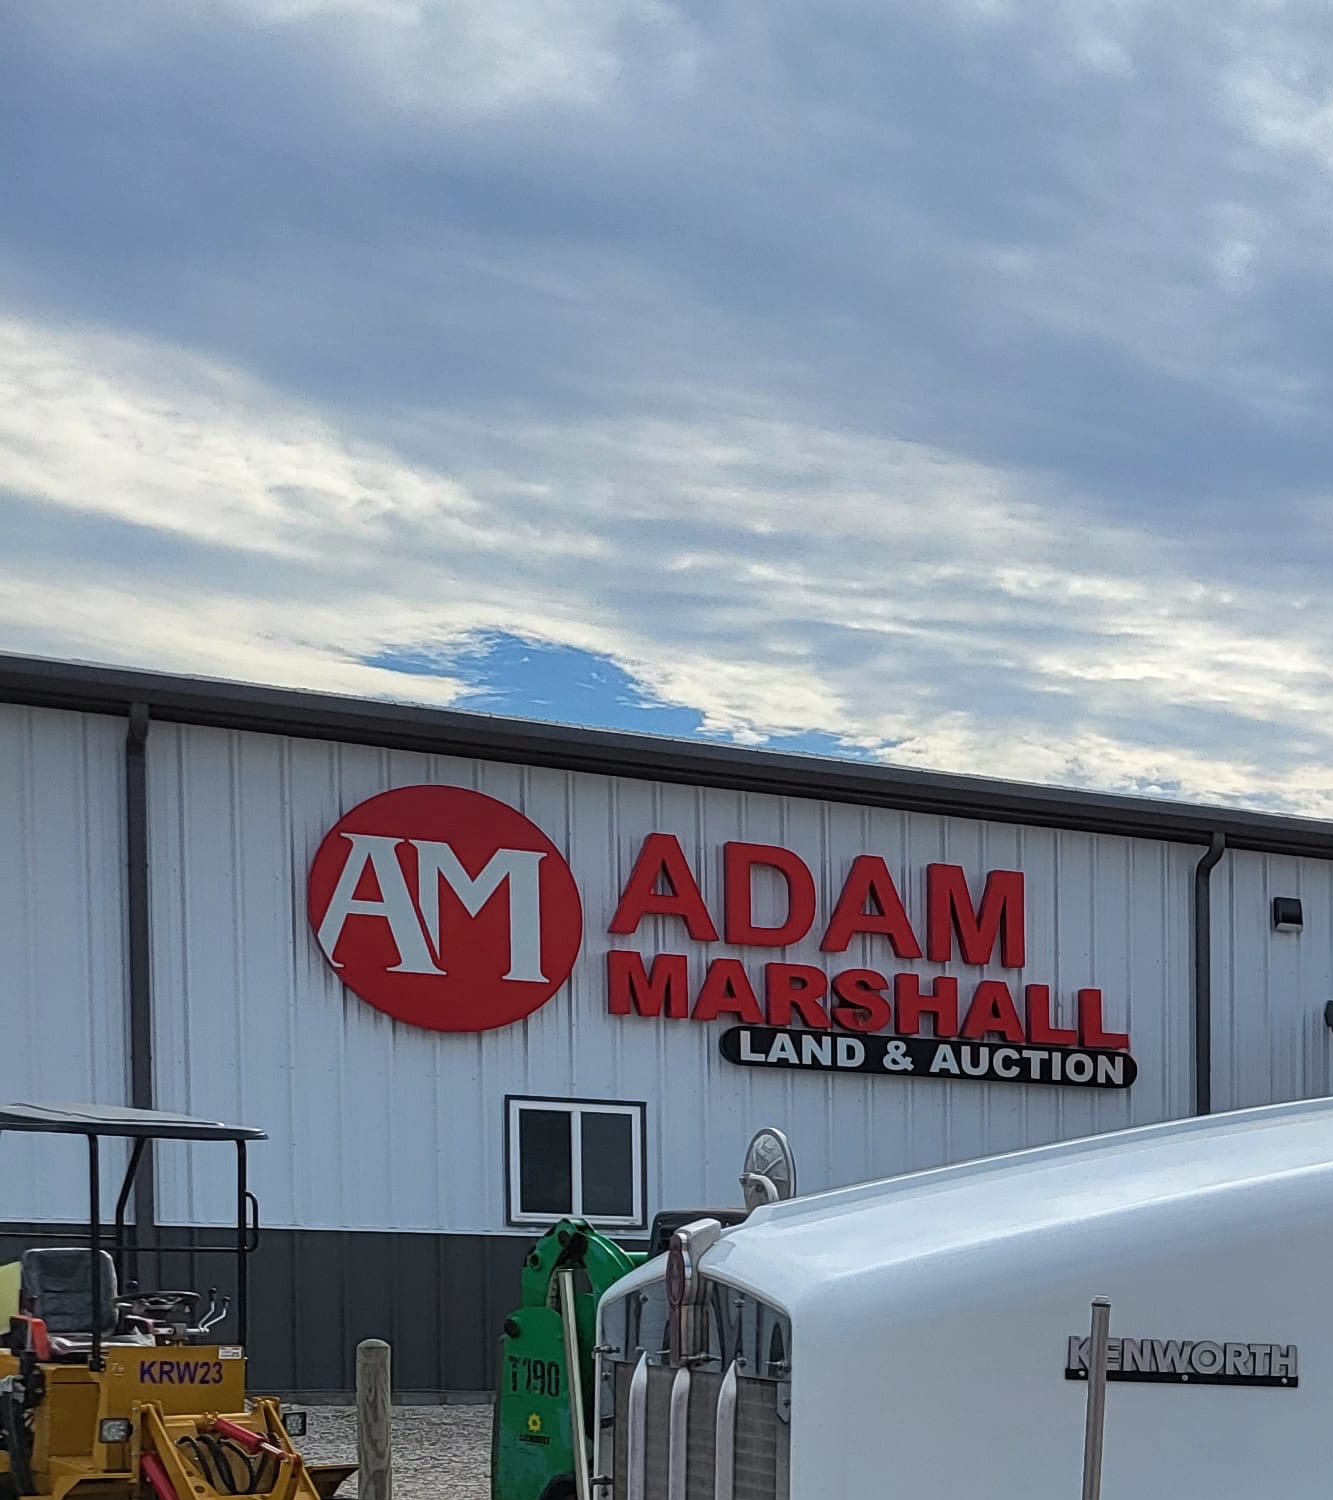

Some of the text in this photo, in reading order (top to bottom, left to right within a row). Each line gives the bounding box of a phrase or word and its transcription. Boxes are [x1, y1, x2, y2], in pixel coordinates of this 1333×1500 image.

[317, 832, 550, 983] AM
[607, 832, 1026, 969] ADAM
[607, 949, 1130, 1050] MARSHALL
[739, 1030, 1125, 1085] LAND & AUCTION
[139, 1359, 223, 1385] KRW23
[1067, 1335, 1299, 1379] KENWORTH
